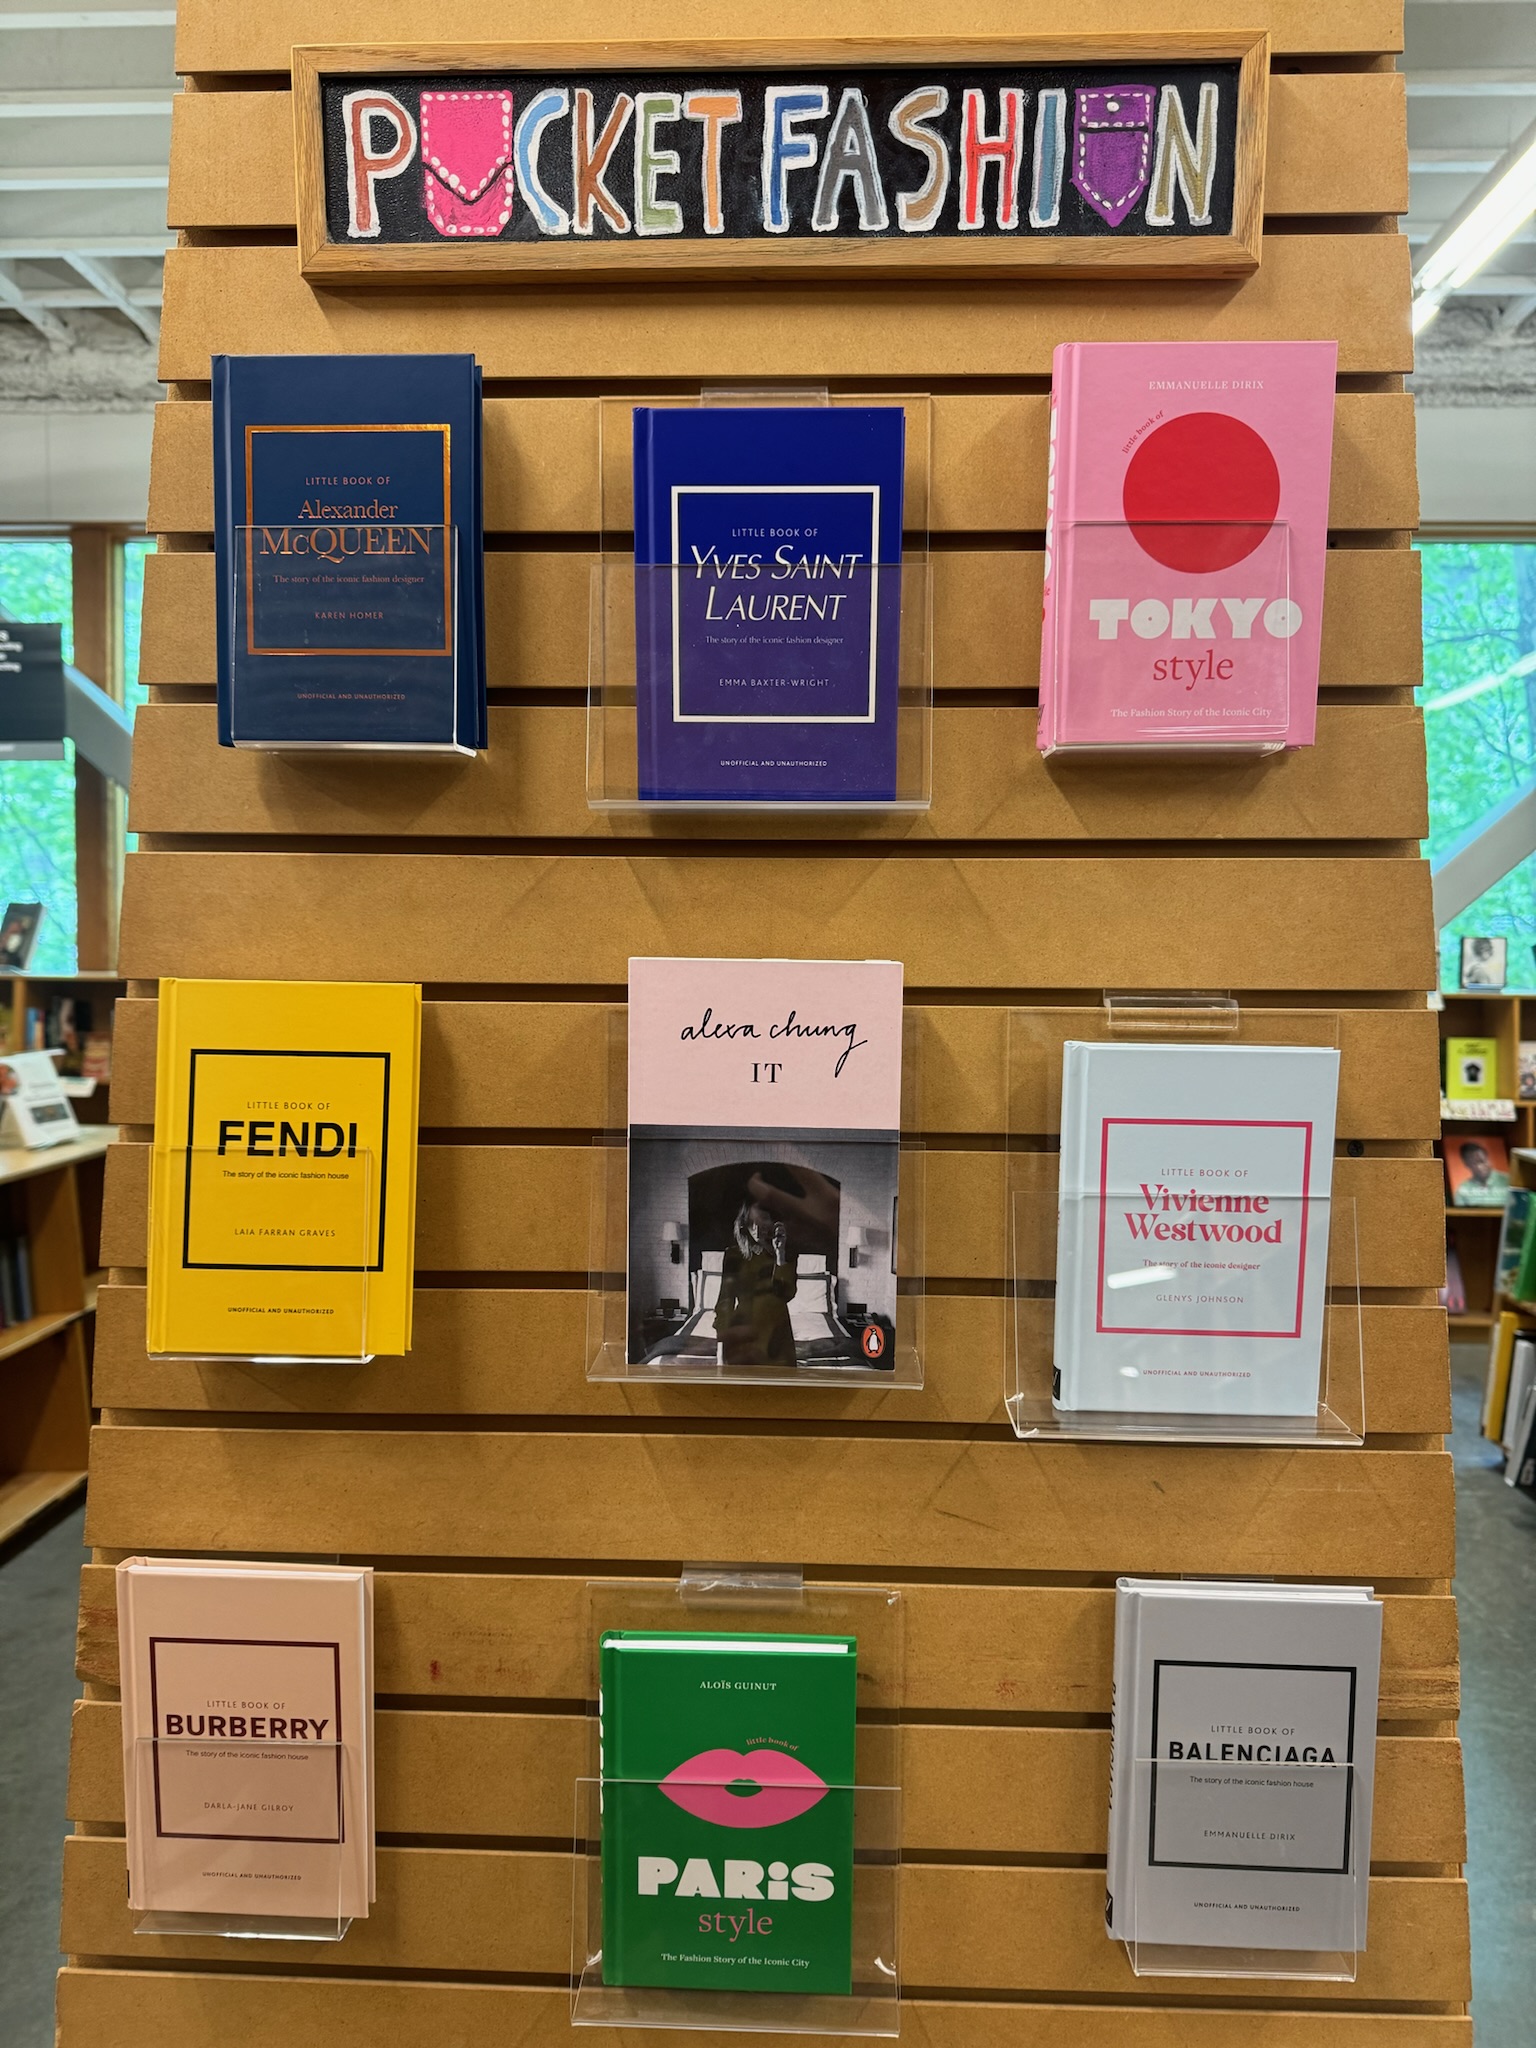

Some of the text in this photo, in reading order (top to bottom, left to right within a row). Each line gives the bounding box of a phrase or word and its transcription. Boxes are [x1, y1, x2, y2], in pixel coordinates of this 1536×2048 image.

[1149, 381, 1264, 390] EMMANUELLE DIRIX
[1122, 409, 1164, 453] little book of
[306, 476, 390, 485] LITTLE BOOK OF
[298, 499, 398, 519] Alexander
[732, 528, 818, 537] LITTLE BOOK OF
[260, 526, 431, 564] McQUEEN
[275, 574, 424, 585] The story of the iconic fashion designer
[315, 612, 384, 620] KAREN HOMER
[1089, 598, 1302, 640] TOKYO
[706, 635, 843, 645] The story of the iconic fashion designer
[1153, 650, 1234, 691] style
[719, 679, 829, 687] EMMA BAXTER-WRIGHT
[297, 692, 336, 700] UNOFFICIAL
[354, 693, 405, 701] UNAUTHORIZED
[1110, 707, 1272, 719] The Fashion Story of the Iconic City
[721, 759, 827, 767] UNOFFICIAL AND UNAUTHORIZED
[681, 1008, 868, 1078] alexa chung
[750, 1062, 783, 1083] IT
[247, 1101, 331, 1110] LITTLE BOOK OF
[217, 1120, 357, 1158] FENDI
[223, 1170, 349, 1180] The story of the iconic fashion house
[1161, 1168, 1249, 1177] LITTLE BOOK OF
[1139, 1183, 1270, 1214] Vivienne
[235, 1229, 336, 1237] LAIA FARRAN GRAVES
[1123, 1213, 1282, 1244] Westwood
[1143, 1259, 1260, 1271] The story of the iconic designer
[1156, 1295, 1244, 1303] GLENYS JOHNSON
[228, 1306, 265, 1314] UNOFFICIAL
[283, 1307, 334, 1315] UNAUTHORIZED
[1143, 1369, 1181, 1377] UNOFFICIAL
[1200, 1371, 1251, 1379] UNAUTHORIZED
[734, 1682, 776, 1690] GUINUT
[207, 1701, 286, 1710] LITTLE BOOK OF
[165, 1714, 329, 1739] BURBERRY
[1210, 1725, 1295, 1735] LITTLE BOOK OF
[746, 1737, 799, 1752] little book of
[186, 1749, 309, 1761] The story of the iconic fashion house
[1168, 1741, 1337, 1768] BALENCIAGA
[1190, 1776, 1314, 1789] The story of the iconic fashion house
[204, 1802, 294, 1812] DARLA-JANE GILROY
[1204, 1829, 1296, 1841] EMMANUELLE DIRIX
[202, 1871, 237, 1879] UNOFFICIAL
[255, 1873, 302, 1881] UNAUTHORIZED
[1193, 1902, 1301, 1912] UNOFFICIAL AND UNAUTHORIZED
[698, 1908, 773, 1942] style
[661, 1953, 810, 1968] The Fashion Story of the Iconic City
